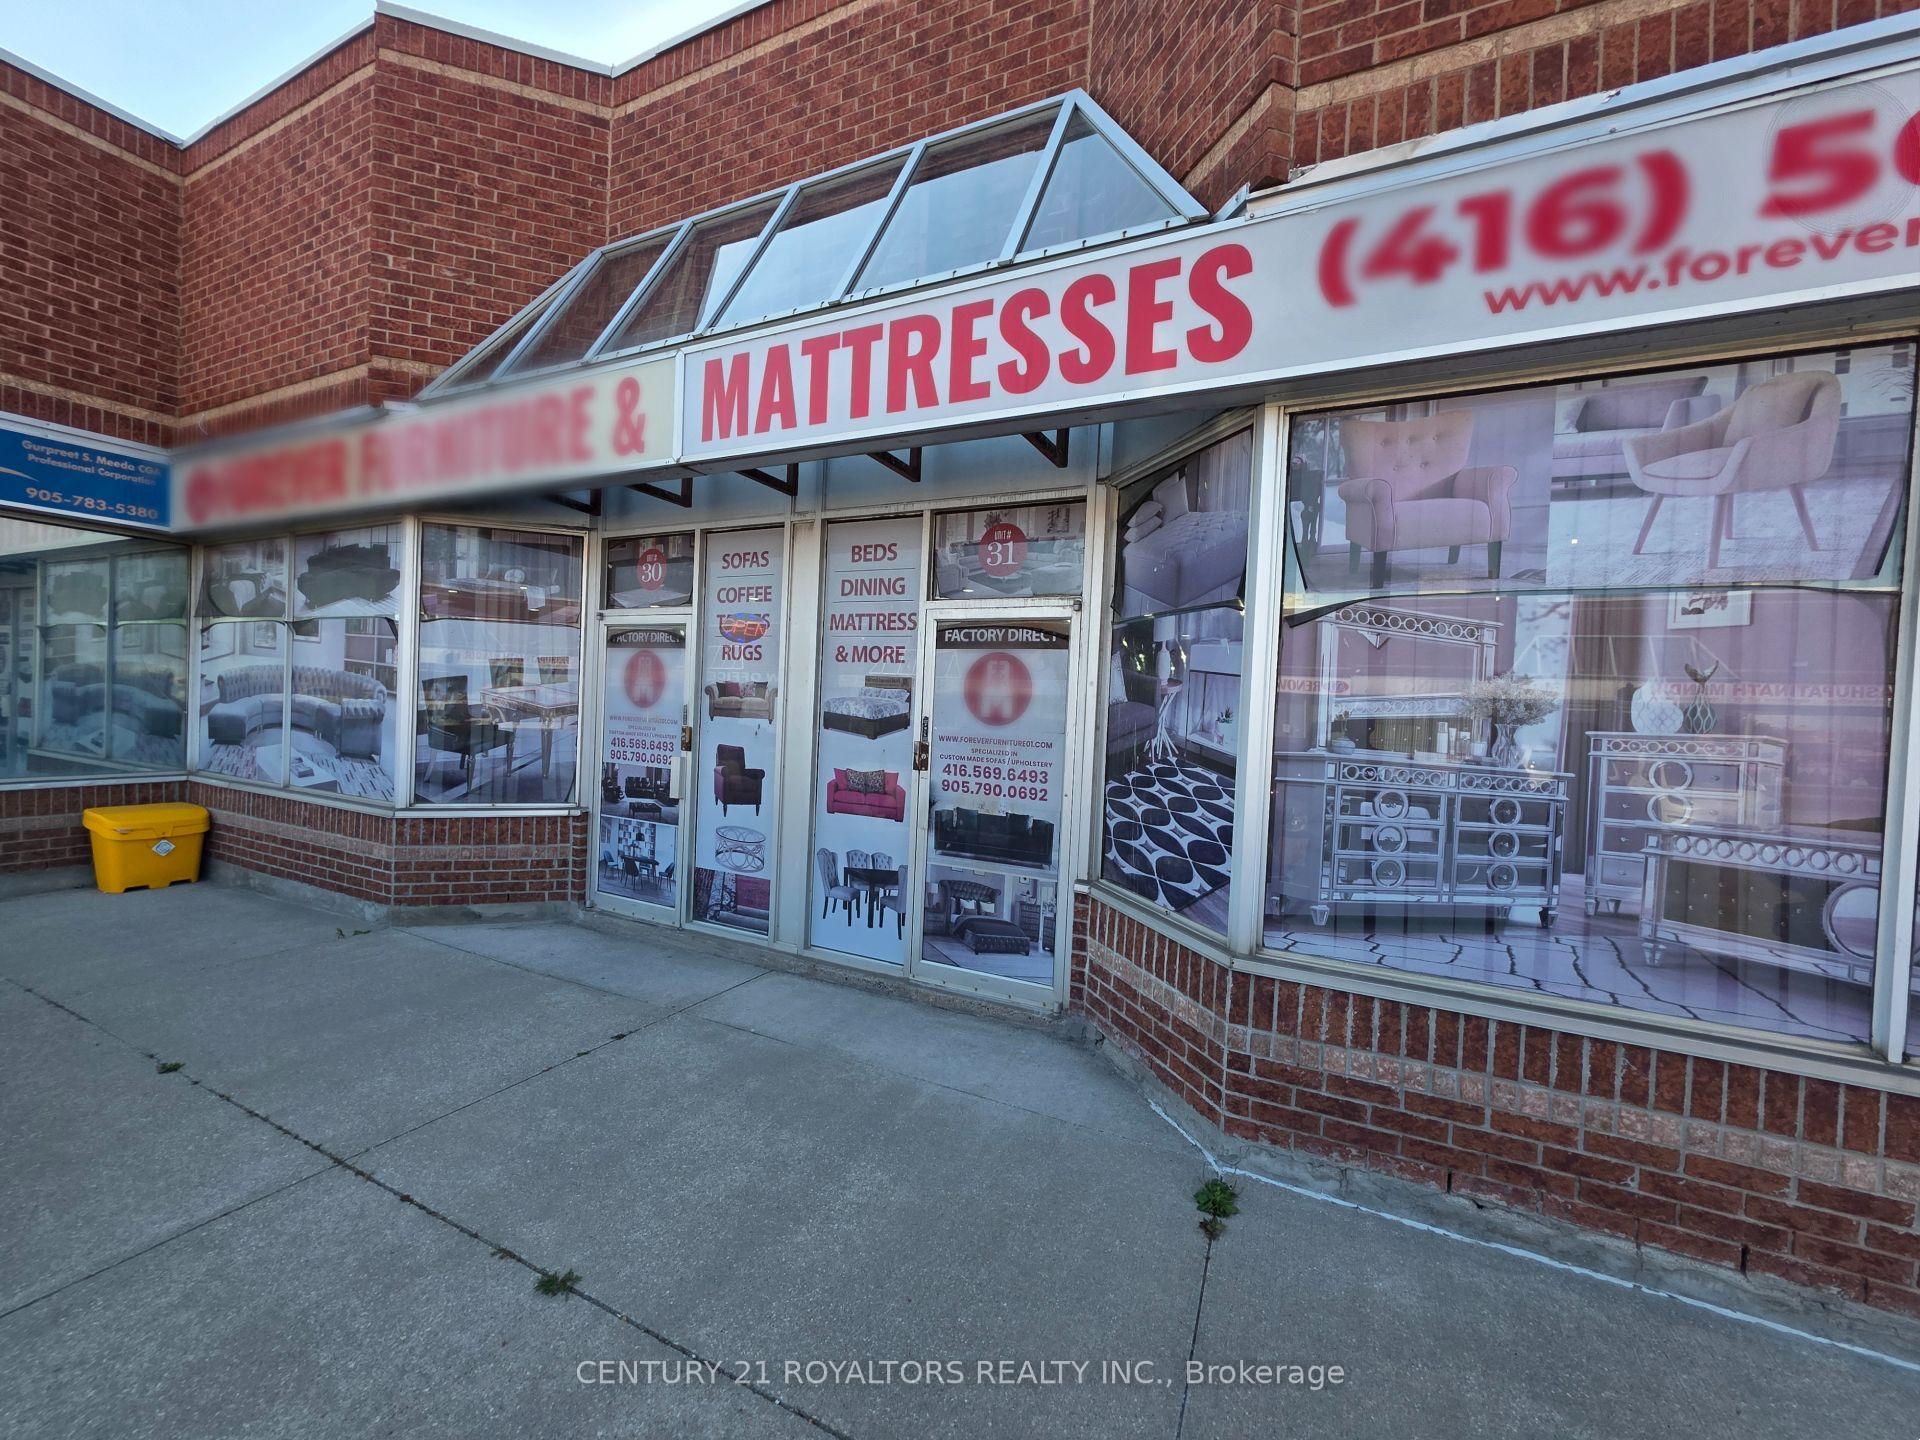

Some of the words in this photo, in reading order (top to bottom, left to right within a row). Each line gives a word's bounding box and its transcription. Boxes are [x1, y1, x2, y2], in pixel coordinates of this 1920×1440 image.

[1318, 148, 1690, 309] (416)
[612, 376, 646, 456] &
[701, 243, 1253, 443] MATTRESSES
[22, 440, 79, 459] Gurpreet
[82, 453, 93, 462] S.
[96, 455, 135, 472] Meeda
[27, 454, 95, 474] Professional
[98, 467, 156, 486] Corporation
[26, 487, 158, 519] 905-783-5380
[722, 551, 769, 570] SOFAS
[851, 543, 897, 563] BEDS
[986, 541, 1018, 566] 31
[641, 562, 662, 582] 30
[717, 585, 772, 603] COFFEE
[840, 577, 905, 597] DINING
[829, 612, 917, 631] MATTRESS
[944, 629, 1005, 642] FACTORY
[722, 645, 762, 661] RUGS
[835, 645, 848, 663] &
[852, 646, 905, 664] MORE
[611, 737, 674, 752] 416.569.6493
[971, 748, 1009, 756] SPECIALIZED
[967, 755, 984, 763] MADE
[986, 757, 1006, 765] SOFAS
[1012, 760, 1053, 768] UPHOLSTERY
[943, 763, 1048, 784] 416.569.6493
[941, 779, 1048, 801] 905.790.0692
